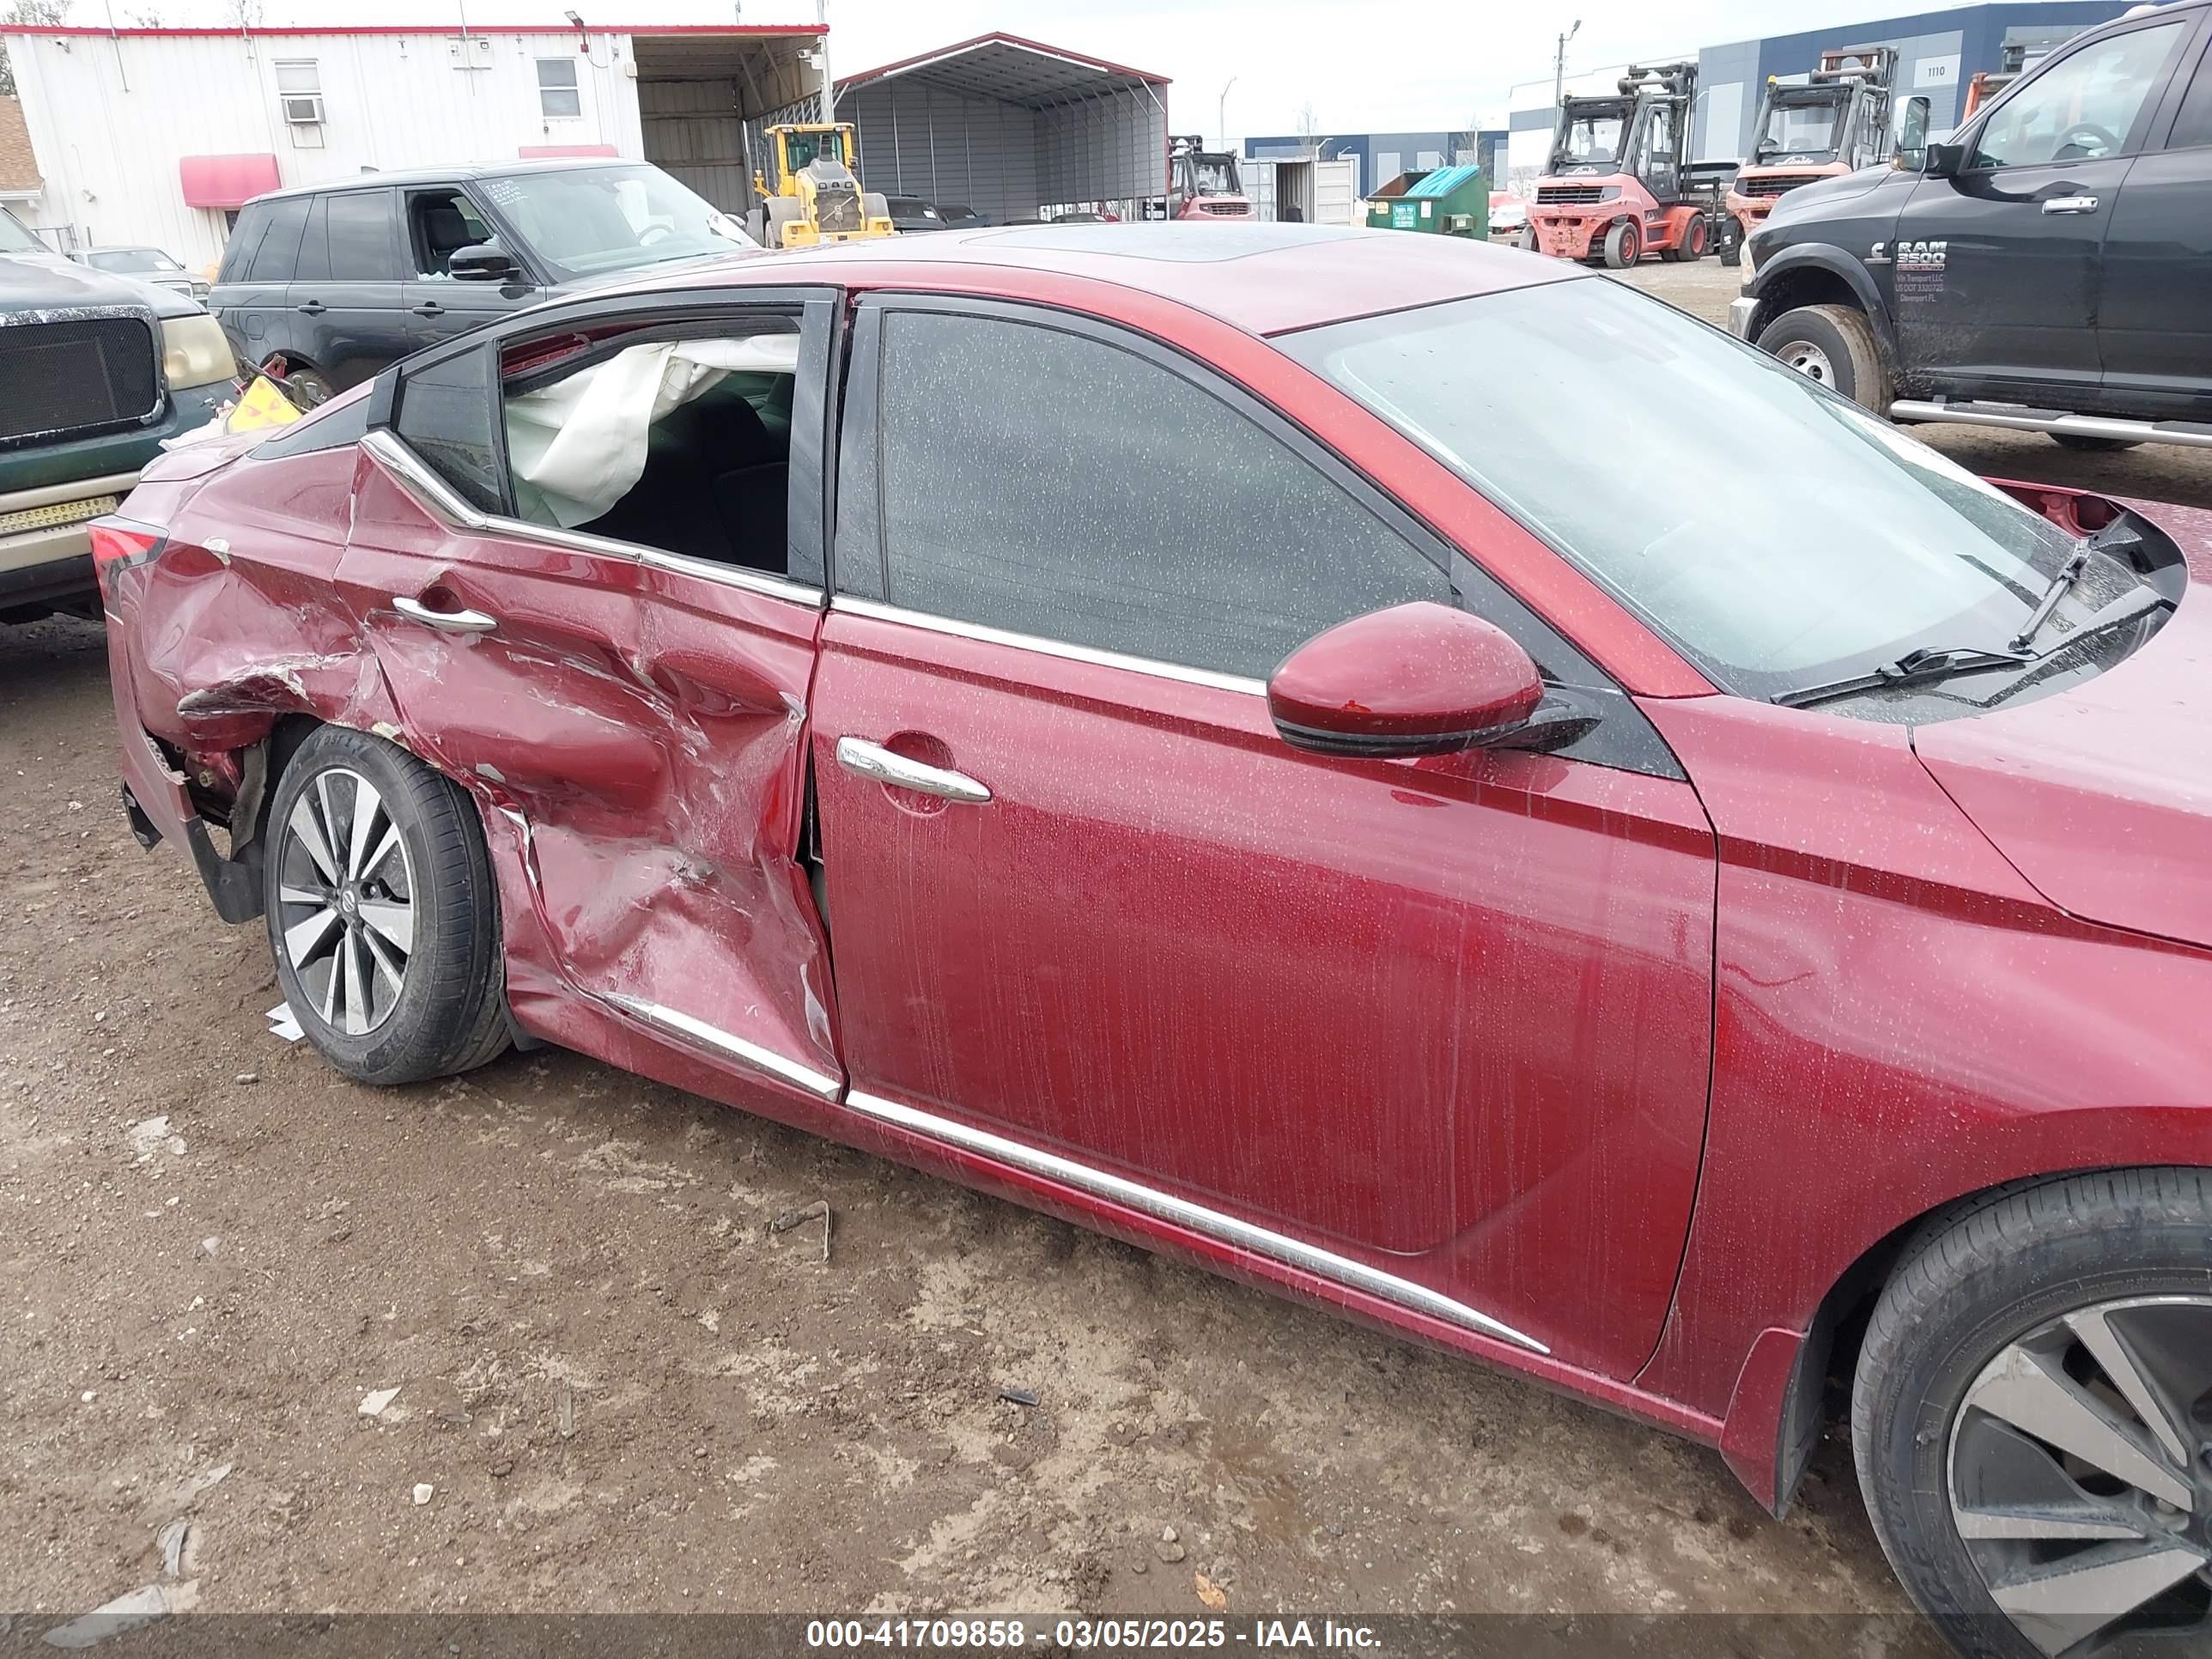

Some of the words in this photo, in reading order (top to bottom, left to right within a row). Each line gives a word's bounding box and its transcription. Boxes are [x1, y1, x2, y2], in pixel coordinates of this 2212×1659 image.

[1928, 65, 1946, 77] 1110
[1897, 241, 1948, 252] RAM
[1896, 252, 1947, 264] 3500
